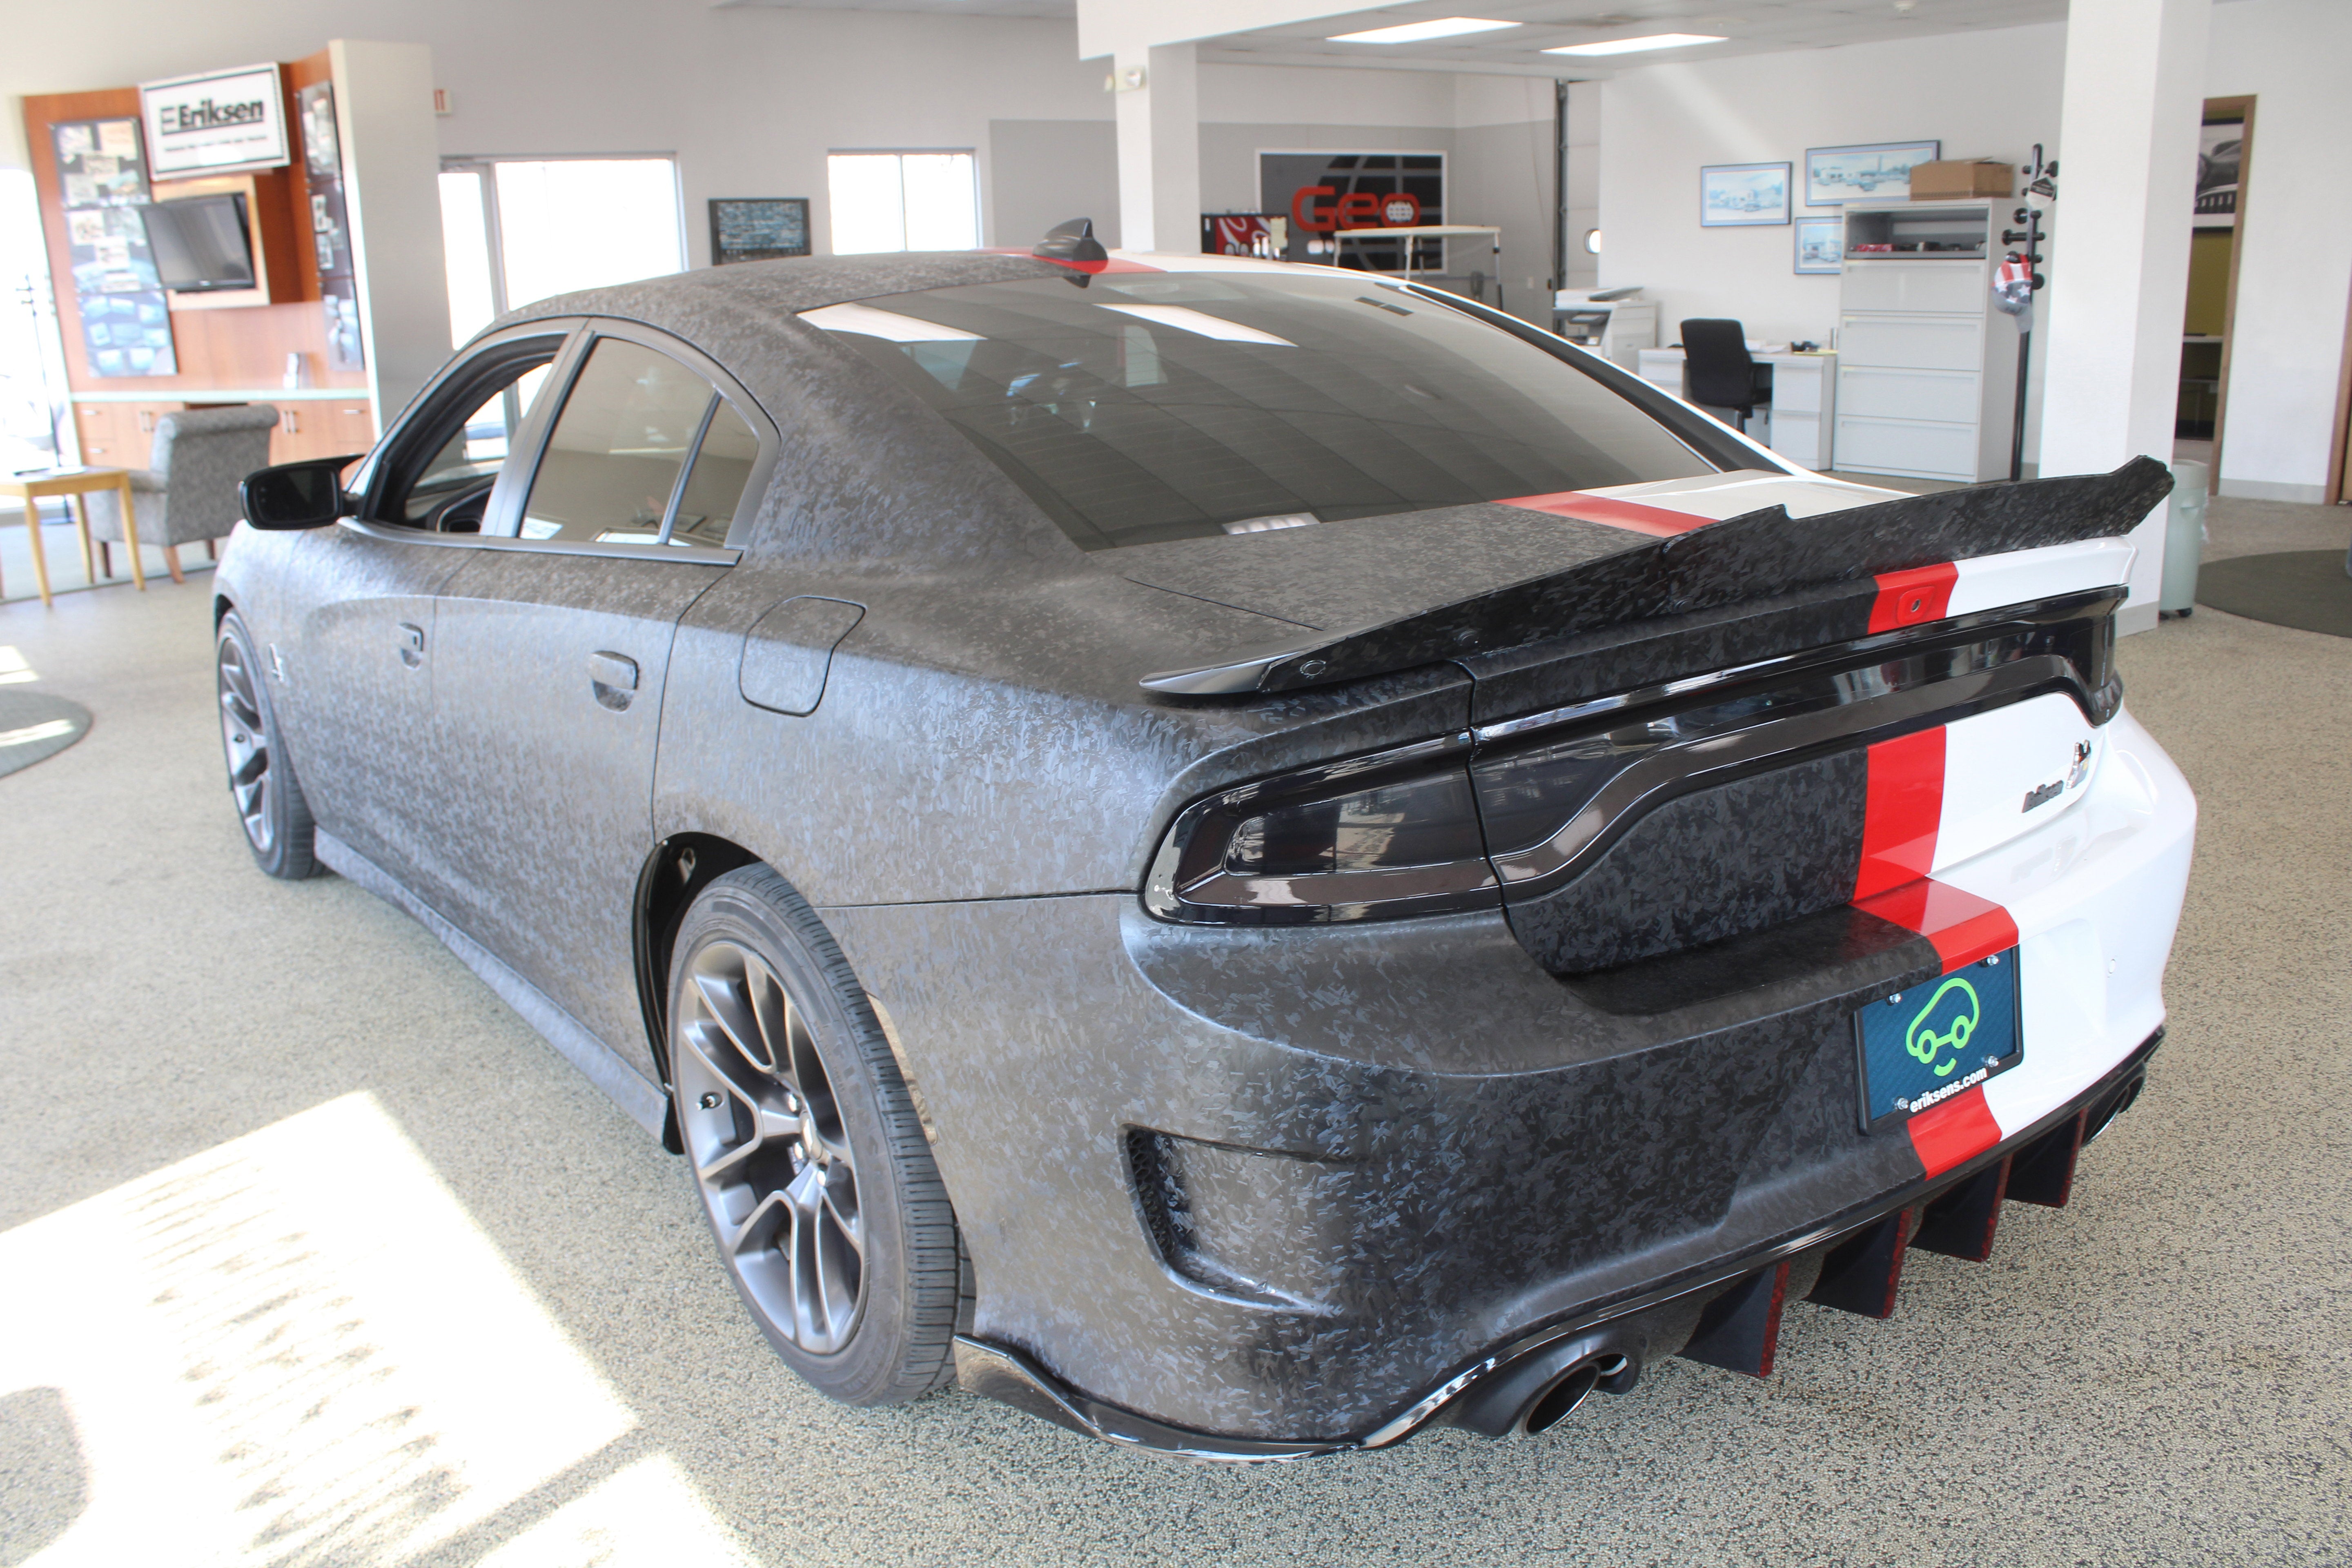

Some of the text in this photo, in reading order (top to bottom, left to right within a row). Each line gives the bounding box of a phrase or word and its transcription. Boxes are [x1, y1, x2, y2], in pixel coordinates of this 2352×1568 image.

[179, 98, 264, 127] Eriksen
[1292, 186, 1421, 232] Geo
[1909, 1067, 1988, 1113] eriksens.com
